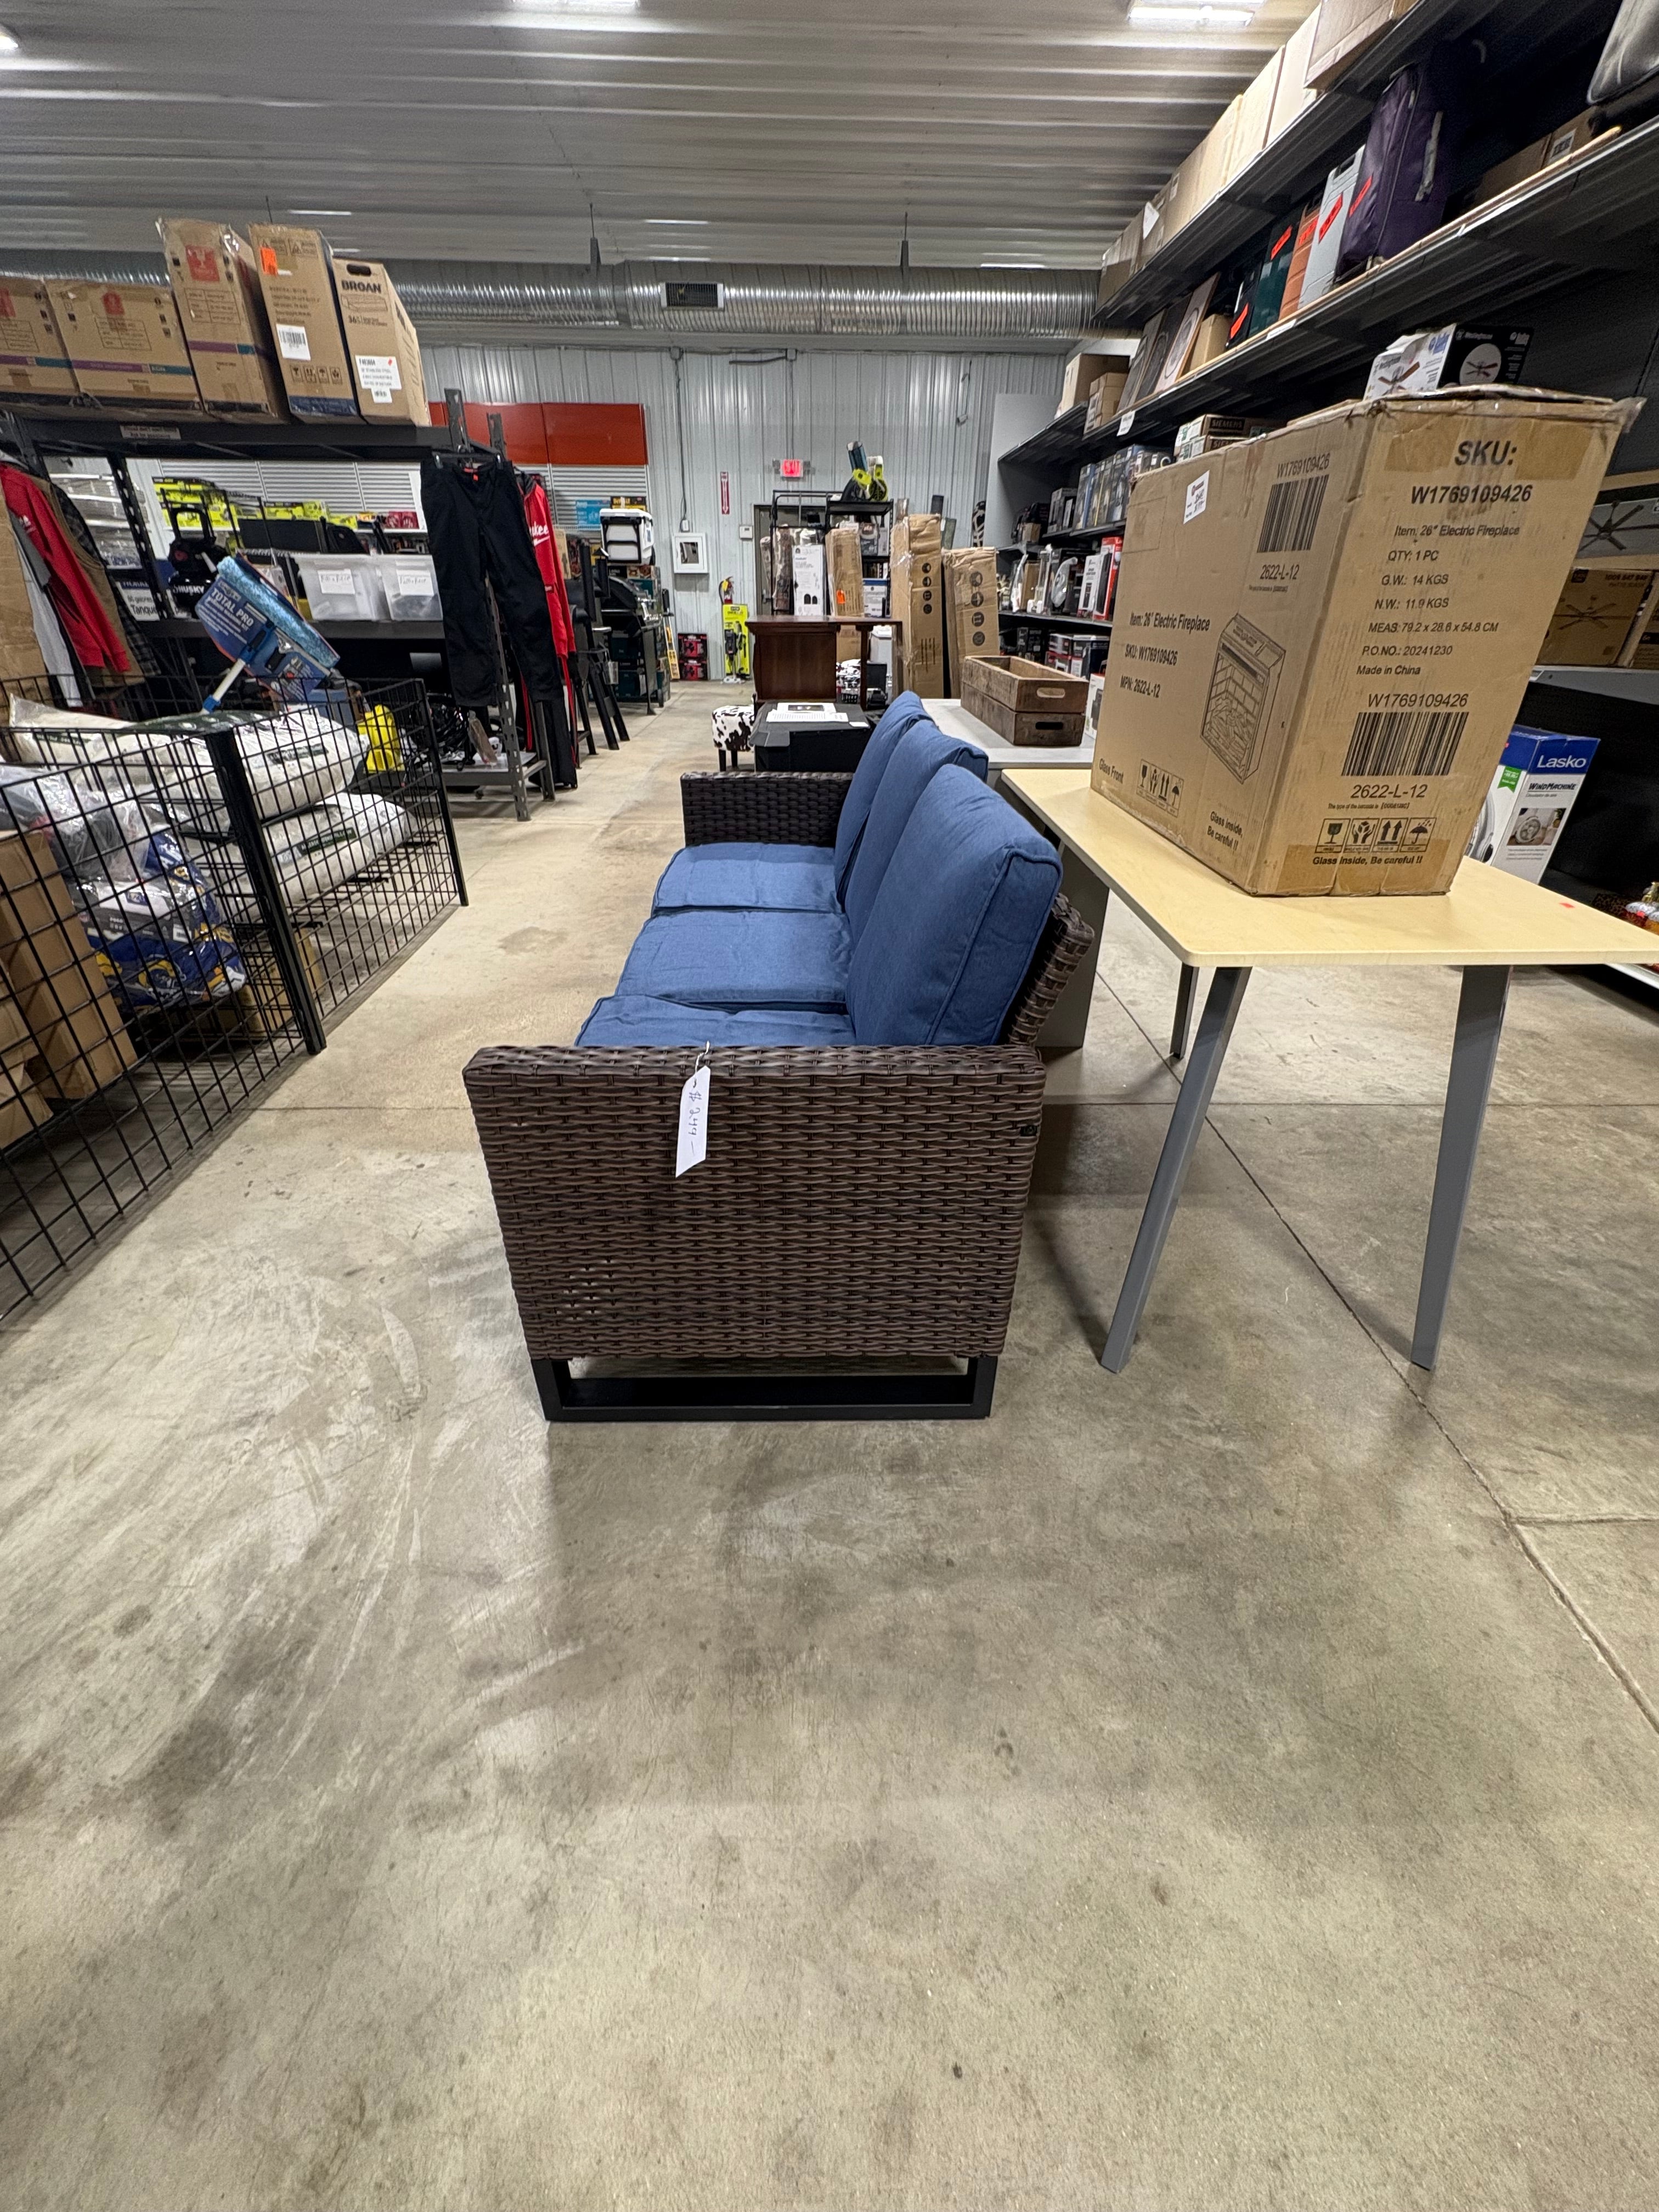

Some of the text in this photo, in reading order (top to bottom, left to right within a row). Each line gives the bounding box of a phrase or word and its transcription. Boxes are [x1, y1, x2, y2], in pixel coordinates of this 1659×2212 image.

[341, 280, 381, 294] BROAN
[1212, 419, 1242, 428] SIEMENS
[1454, 441, 1517, 466] SKU:
[785, 460, 801, 475] EXIT
[1277, 453, 1330, 478] W1769109426
[1411, 484, 1533, 504] W1769109426
[1420, 525, 1438, 537] 26"
[1439, 524, 1475, 537] Electric
[1476, 524, 1520, 538] Fireplace
[1388, 550, 1439, 562] QTY: 1 PC
[1260, 564, 1299, 580] 2622-L-12
[1413, 574, 1424, 585] 14
[1425, 574, 1449, 585] KGS
[178, 585, 205, 595] HUSKY
[211, 588, 235, 613] TOTAL
[236, 608, 254, 627] PRO
[1426, 597, 1449, 608] KGS
[1154, 613, 1177, 629] Electric
[1178, 613, 1210, 634] Fireplace
[1368, 622, 1401, 633] MEAS:
[1482, 622, 1499, 632] CM
[1125, 644, 1178, 665] SKU: W1769109426
[1403, 645, 1453, 656] 20241230
[1356, 665, 1421, 675] Made in China
[1120, 675, 1161, 698] MPN: 2622-L-12
[1368, 693, 1469, 708] W1769109426
[1537, 755, 1587, 768] Lasko
[1099, 758, 1124, 784] Glass Front
[1350, 783, 1428, 799] 2622-L-12
[1210, 811, 1224, 827] Glass
[1207, 825, 1214, 838] Be
[1215, 832, 1233, 849] careful
[1313, 856, 1337, 865] Glass
[1370, 856, 1383, 865] Be
[1384, 856, 1414, 865] careful
